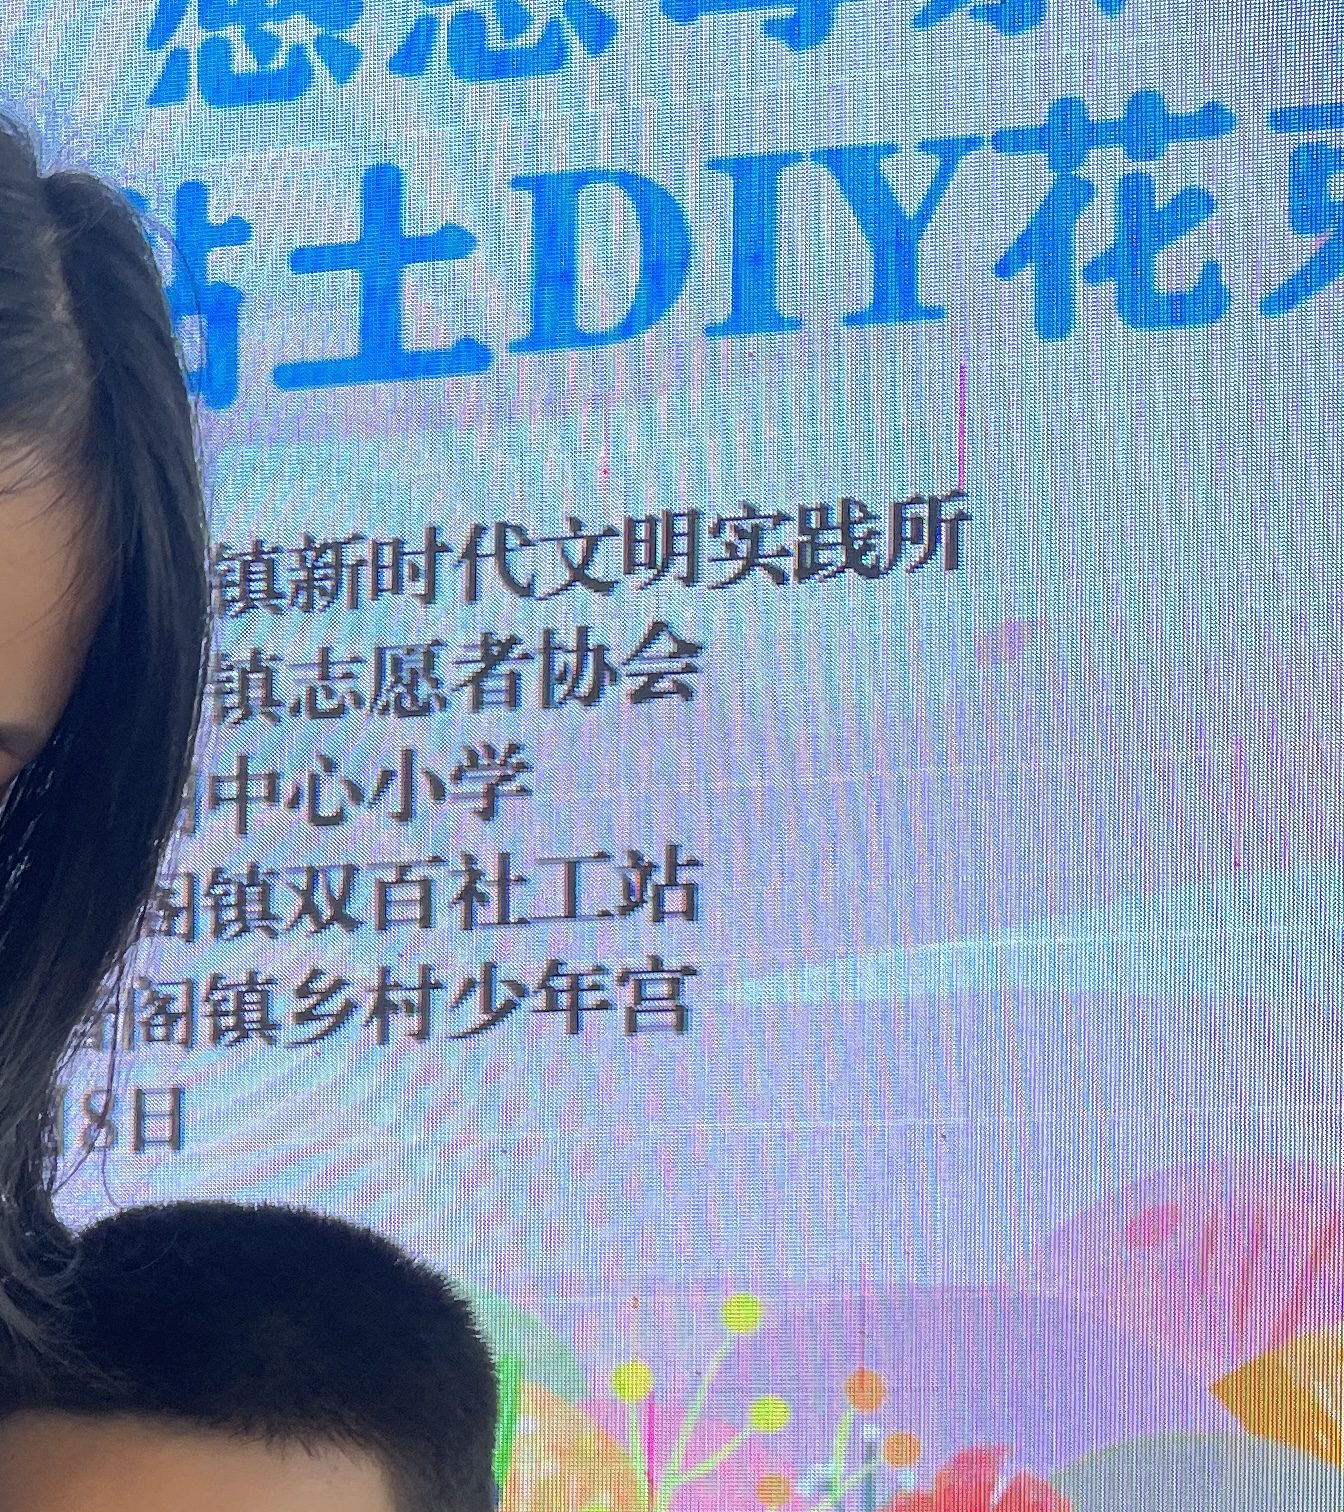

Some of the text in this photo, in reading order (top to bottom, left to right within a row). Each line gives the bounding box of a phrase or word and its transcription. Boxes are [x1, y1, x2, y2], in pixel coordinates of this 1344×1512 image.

[210, 489, 972, 617] 镇新时代文明实践所
[207, 620, 704, 727] 镇志愿者协会
[184, 742, 534, 837] 中心小学
[85, 955, 701, 1051] 阁镇乡村少年宫
[56, 1084, 185, 1156] 8日
